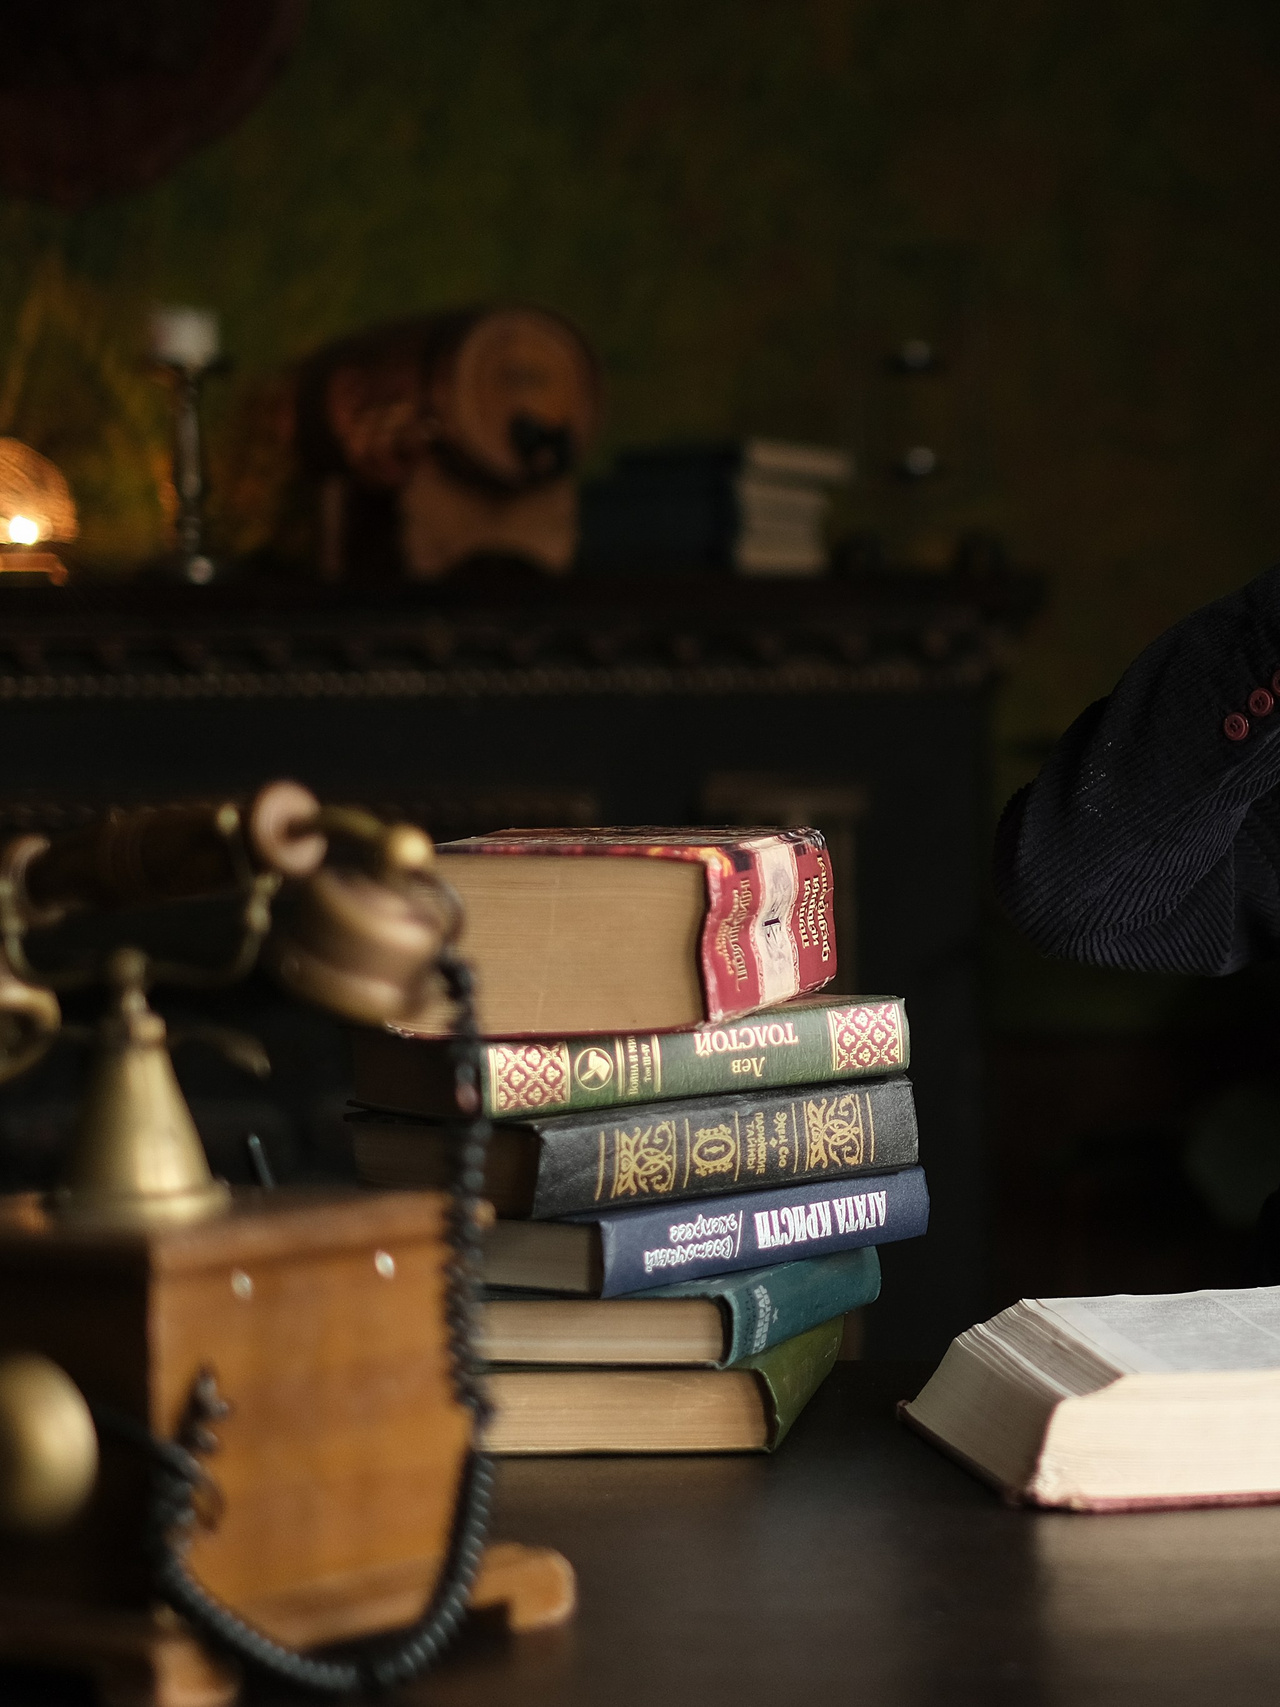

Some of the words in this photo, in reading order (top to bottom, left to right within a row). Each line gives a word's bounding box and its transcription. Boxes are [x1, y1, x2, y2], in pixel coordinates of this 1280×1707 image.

[694, 1022, 798, 1057] ТОЛСТОЙ
[731, 1056, 765, 1077] Лев
[746, 1120, 757, 1169] ТАЙНЫ
[755, 1112, 768, 1174] ПАРИЖСКИЕ
[670, 1213, 738, 1243] экспресс
[754, 1200, 833, 1249] КРИСТИ
[833, 1190, 887, 1234] АГАТА
[645, 1235, 733, 1273] Восточный
